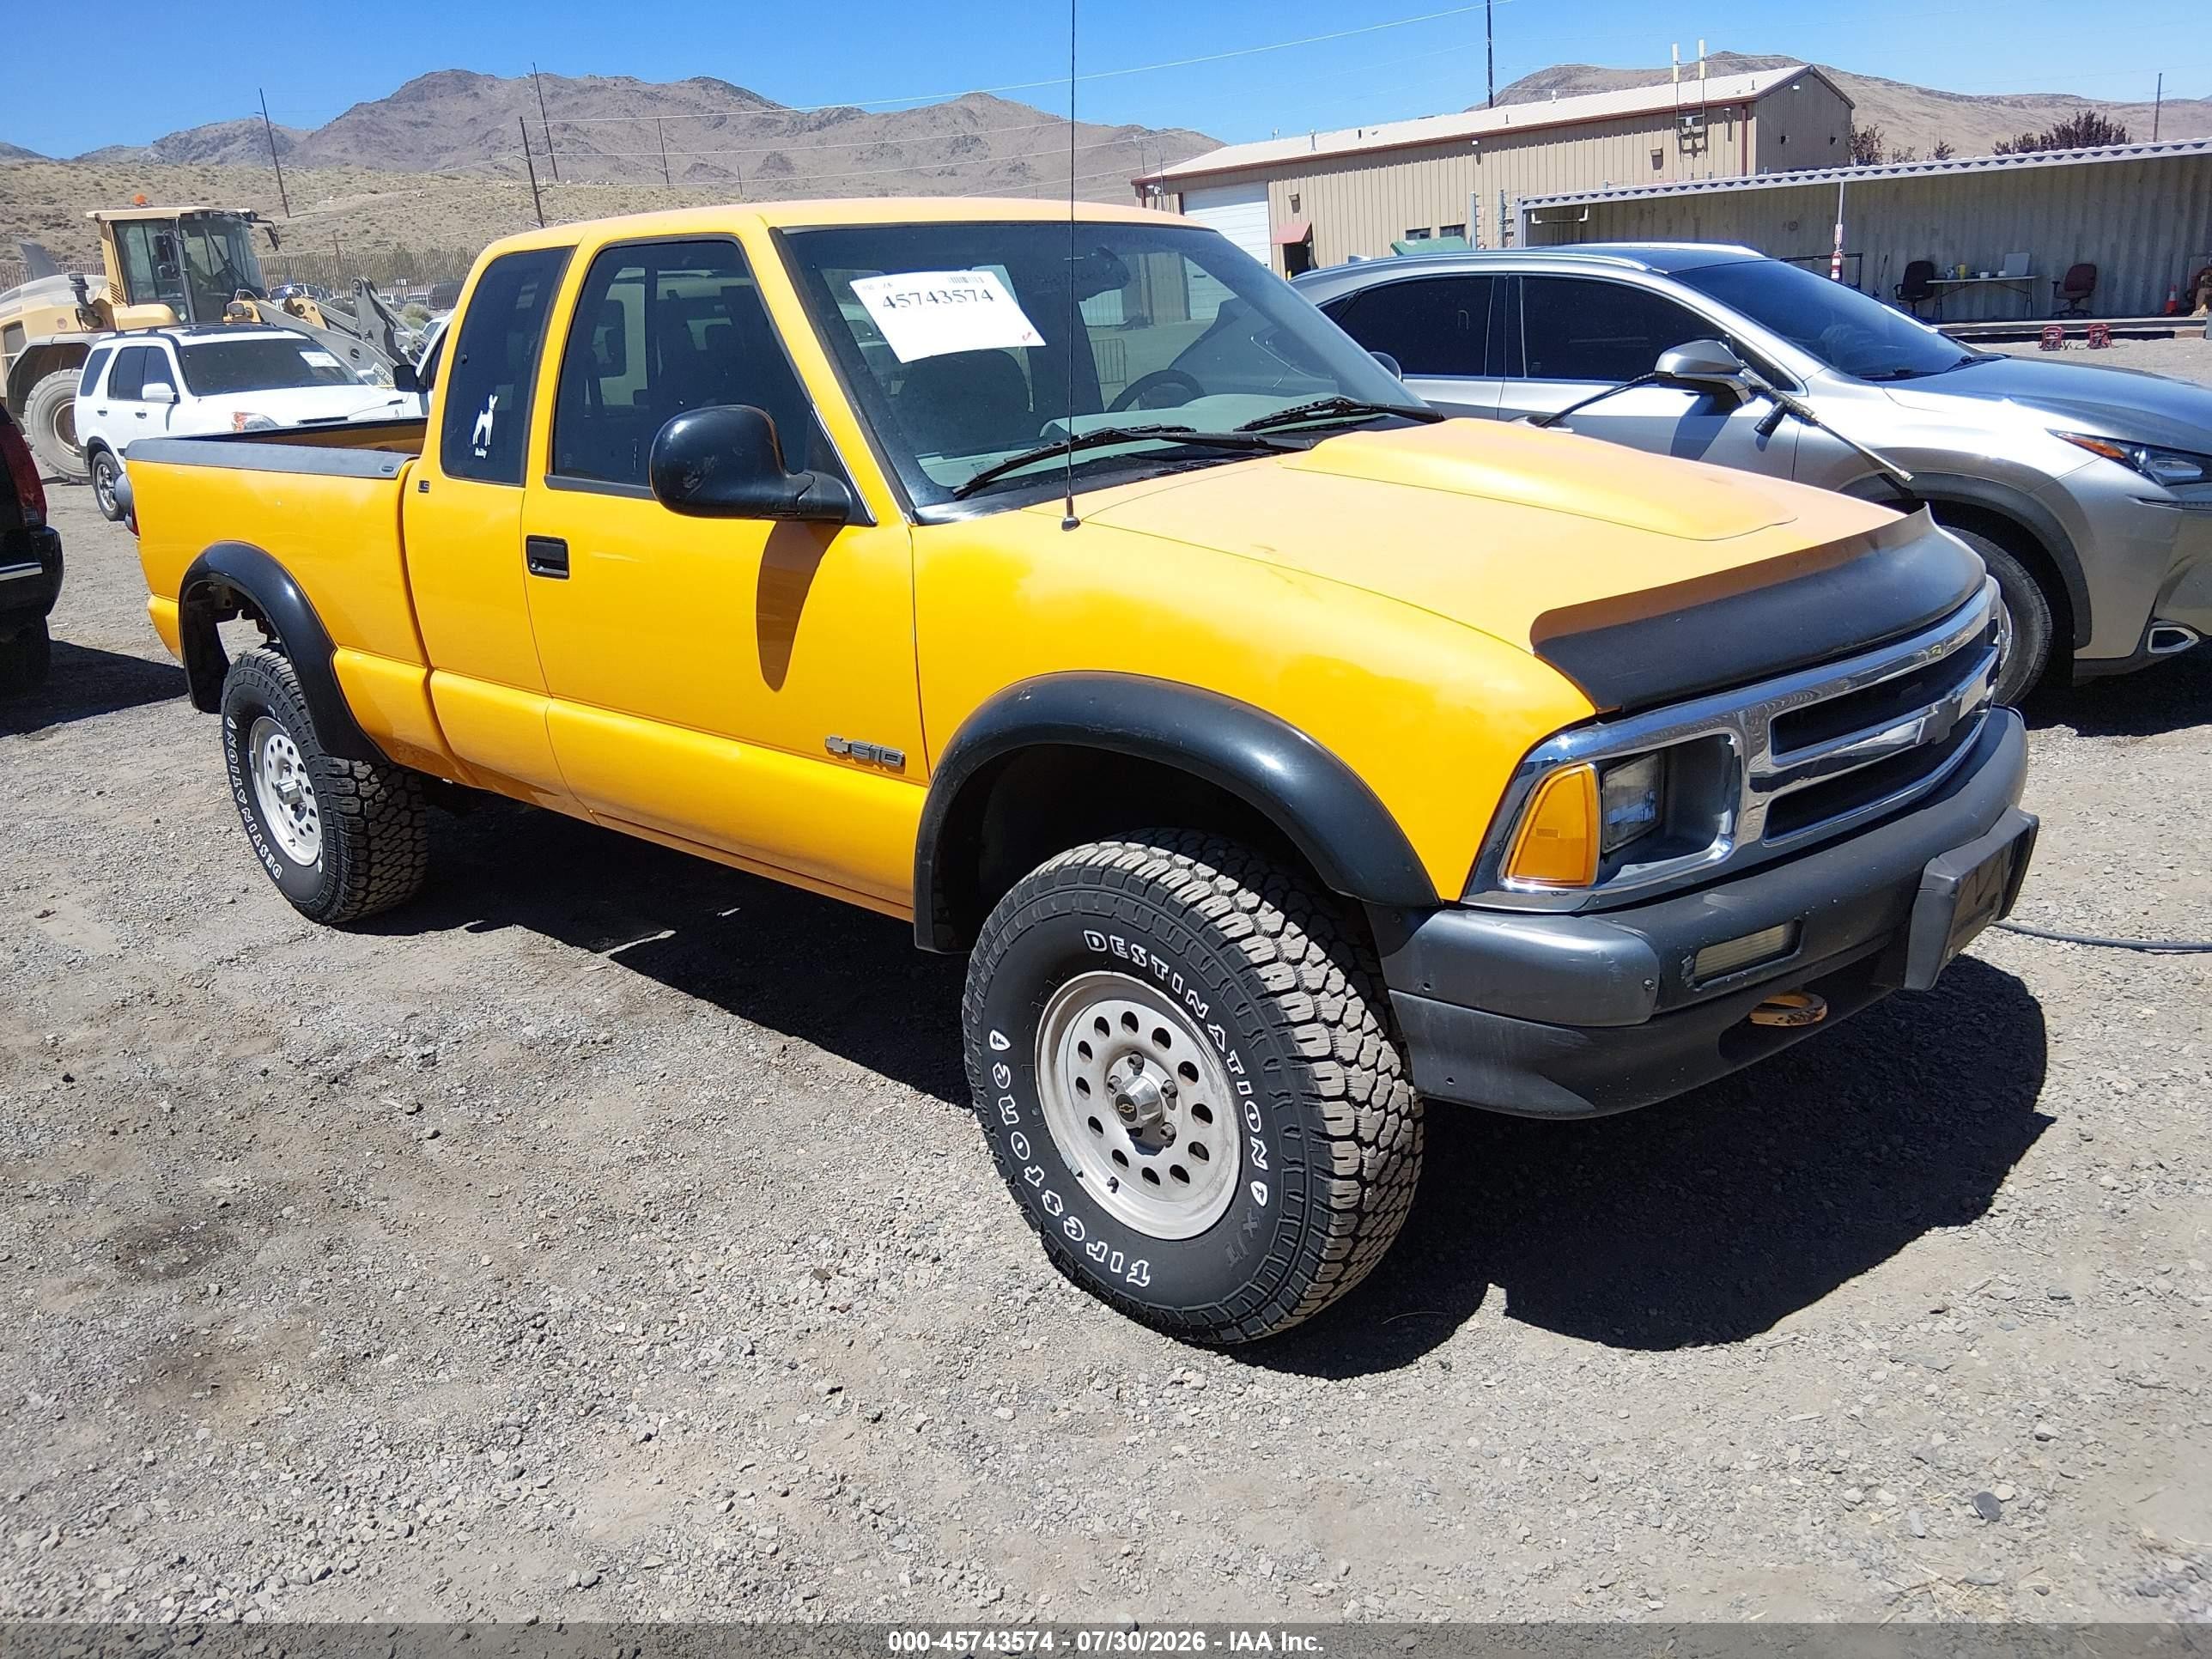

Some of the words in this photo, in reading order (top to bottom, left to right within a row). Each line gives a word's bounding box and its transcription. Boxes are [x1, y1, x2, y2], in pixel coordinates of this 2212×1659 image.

[883, 289, 994, 308] 45743574
[227, 732, 283, 879] DESTINATION
[1083, 929, 1270, 1171] DESTINATION
